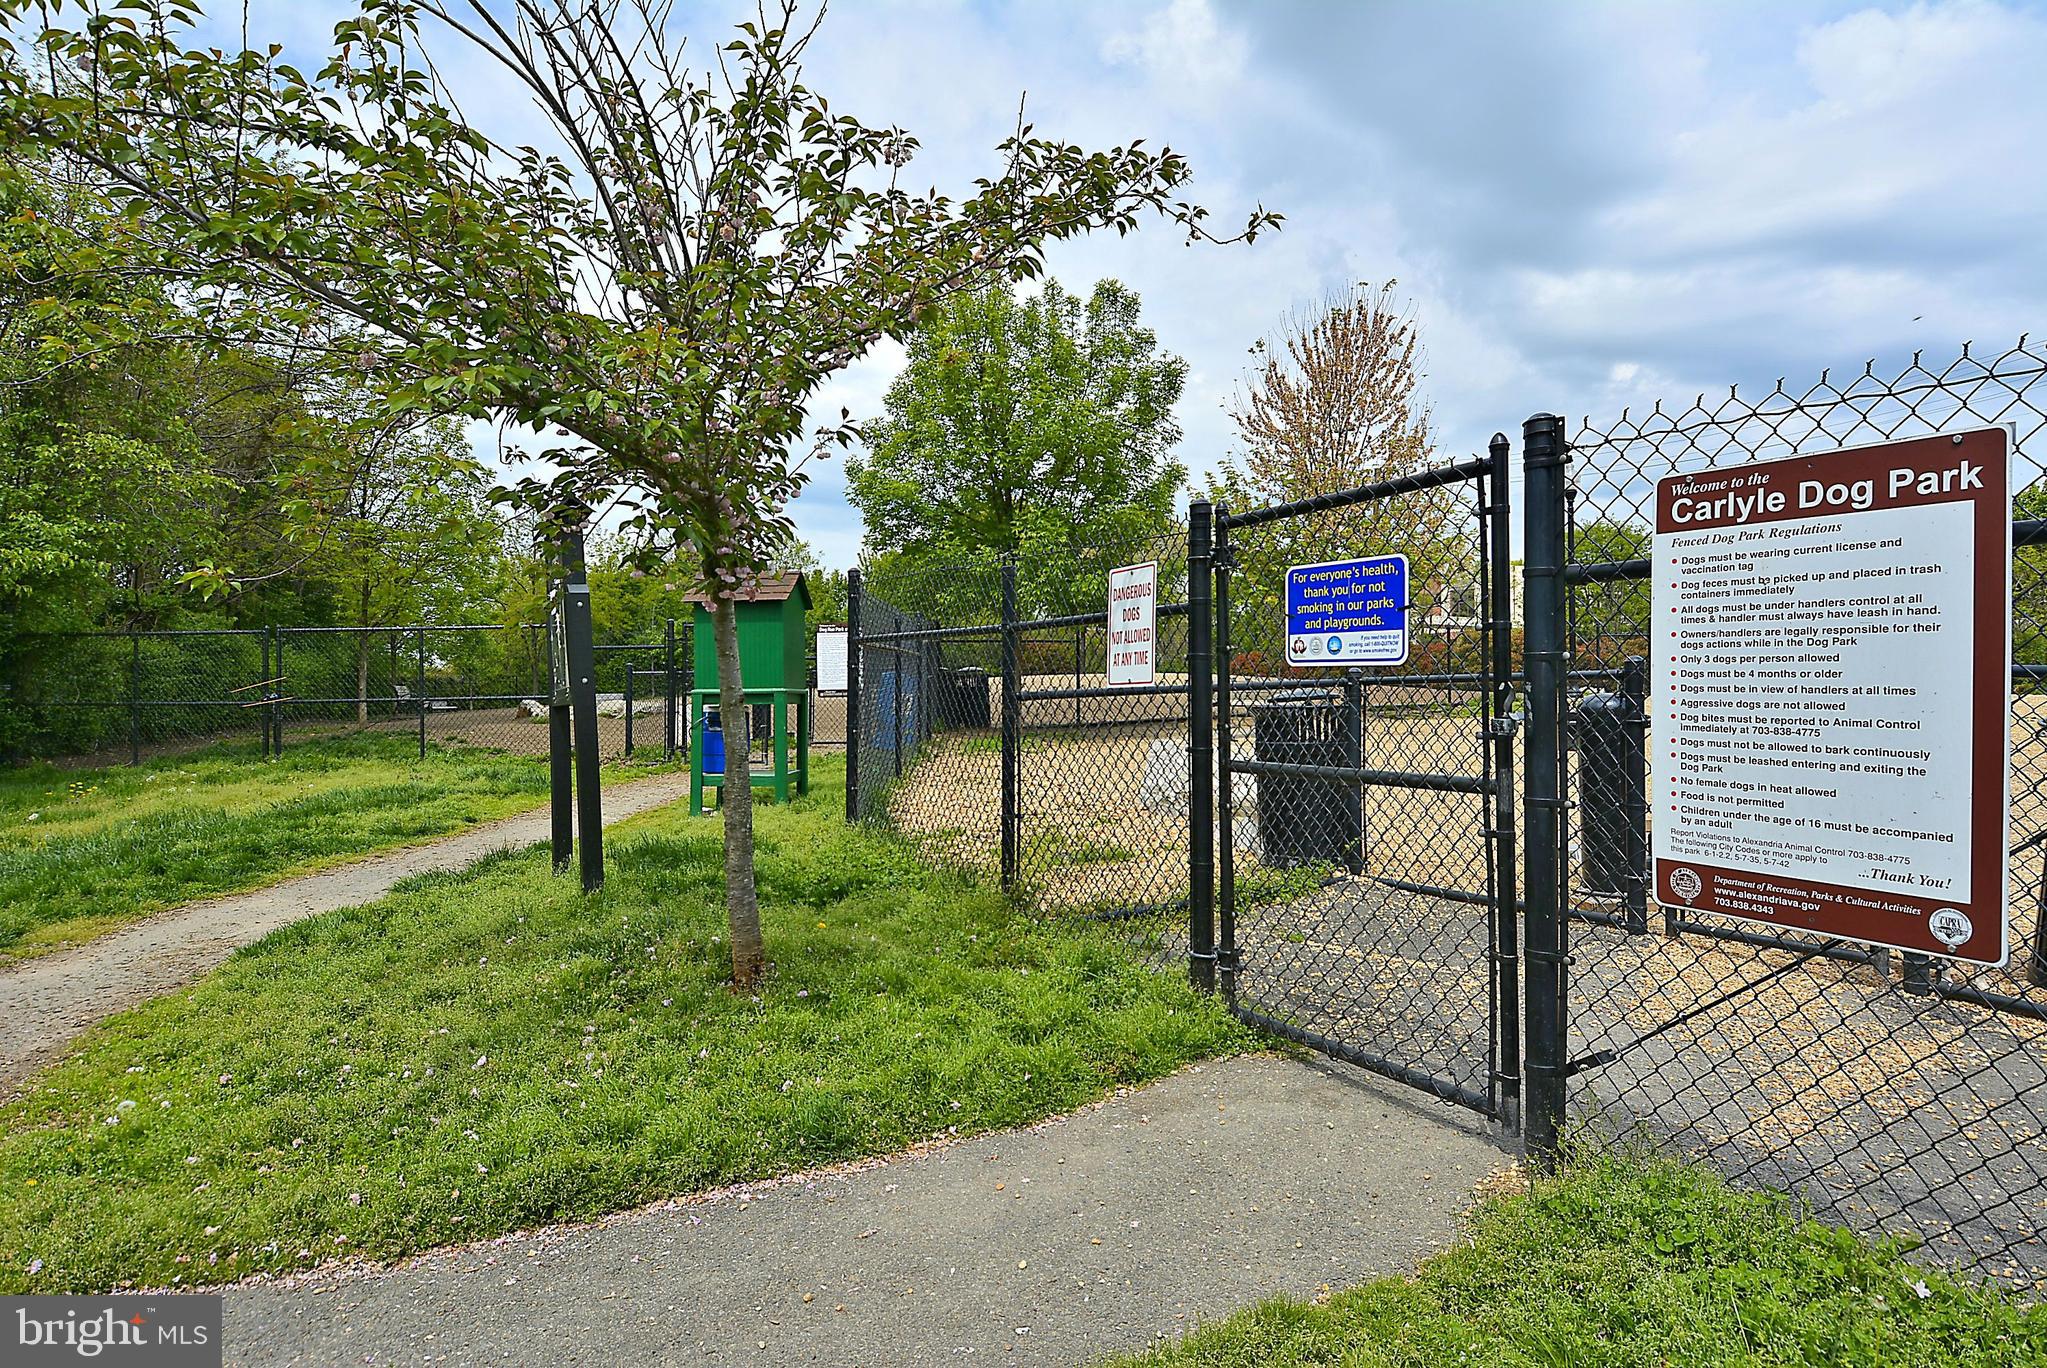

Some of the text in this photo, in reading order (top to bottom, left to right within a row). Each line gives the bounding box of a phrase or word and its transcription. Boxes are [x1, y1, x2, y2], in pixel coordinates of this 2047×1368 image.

[1671, 473, 1769, 496] Welcome to the
[1671, 460, 1983, 522] Carlyle Dog Park
[1671, 523, 1842, 547] Fenced Dog Park Regulations
[1681, 537, 1901, 565] Dogs must be wearing current license and
[1293, 562, 1399, 583] For everyone's health,
[1681, 562, 1753, 574] vaccination tag
[1113, 583, 1151, 601] DANGEROUS
[1304, 581, 1385, 599] thank you for not
[1297, 597, 1394, 615] smoking in our parks
[1680, 593, 1922, 614] All dogs must be under handlers control at all
[1123, 607, 1140, 622] DOGS
[1305, 614, 1385, 630] and playgrounds.
[1680, 605, 1940, 624] times & handler must always have leash in hand.
[1112, 628, 1150, 645] NOT ALLOWED
[1680, 628, 1761, 638] Owners/handlers
[1784, 626, 1818, 637] legally
[1822, 624, 1889, 636] responsible
[1892, 623, 1909, 632] for
[1913, 622, 1941, 632] their
[1680, 636, 1857, 650] dogs actions while in the Dog Park
[1113, 651, 1148, 667] AT ANY TIME
[1680, 653, 1839, 664] Only 3 dogs per person allowed
[1680, 669, 1704, 679] Dogs
[1733, 669, 1745, 677] be
[1748, 669, 1754, 677] 4
[1757, 669, 1796, 678] months
[1814, 669, 1843, 678] older
[1680, 698, 1845, 710] Aggressive dogs are not allowed
[1680, 713, 1920, 729] Dog bites must be reported to Animal Control
[1680, 722, 1820, 737] immediately at 703-838-4775
[1680, 737, 1930, 761] Dogs must not be allowed to bark continuously
[1680, 751, 1926, 776] Dogs must be leashed entering and exiting the
[1680, 762, 1723, 773] Dog Park
[1680, 776, 1836, 797] No female dogs in heat allowed
[1680, 790, 1784, 808] Food is not permitted
[1680, 815, 1691, 825] by
[1708, 819, 1732, 829] adult
[1680, 805, 1953, 842] Children under the age of 16 must be accompanied
[1919, 874, 1951, 889] You!
[1713, 887, 1820, 910] www.alexandriava.gov
[1714, 896, 1773, 914] 703.838.4343
